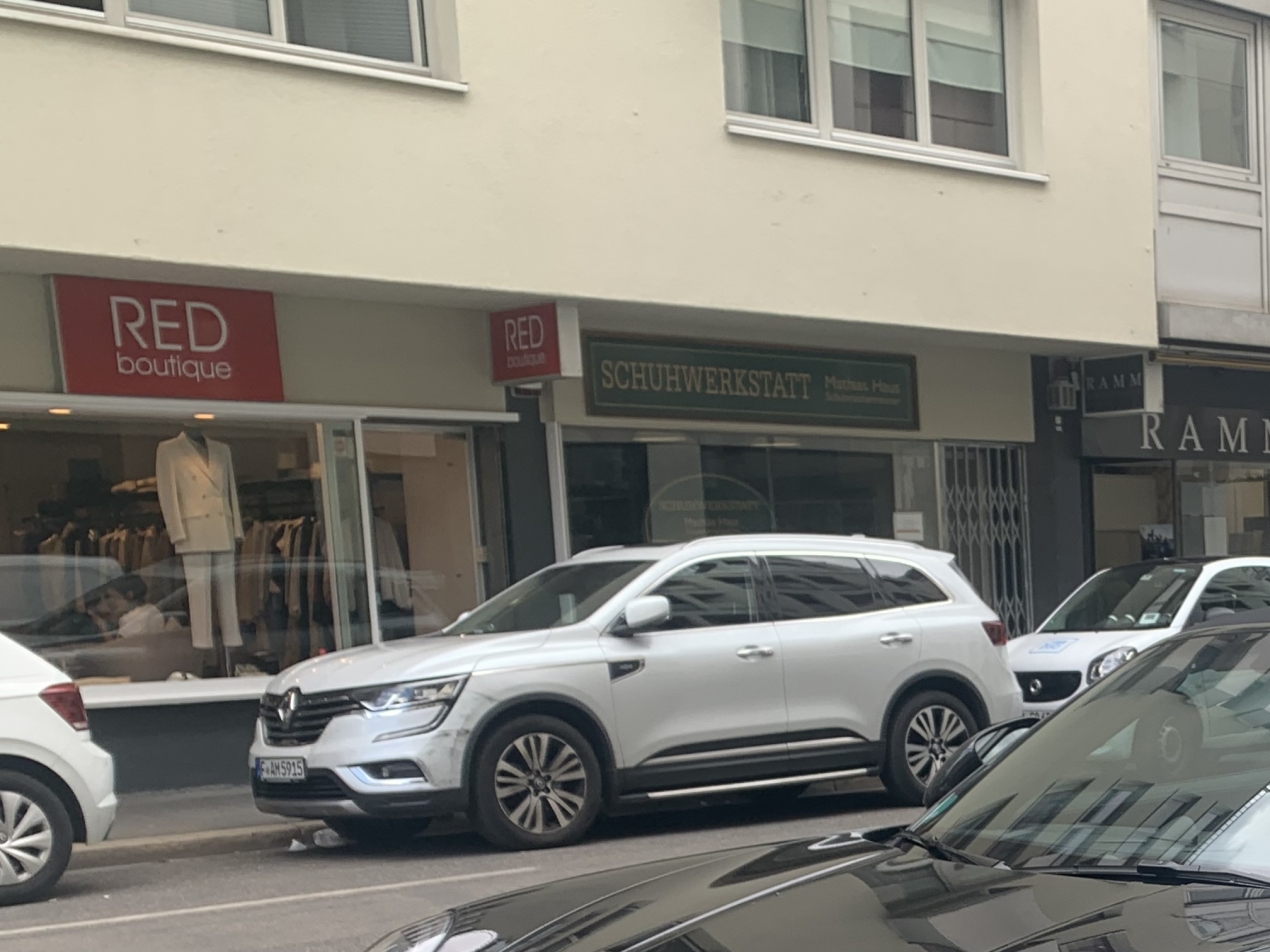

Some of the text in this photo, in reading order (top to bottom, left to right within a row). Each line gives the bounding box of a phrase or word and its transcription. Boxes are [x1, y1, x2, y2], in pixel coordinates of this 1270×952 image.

[110, 296, 228, 353] RED
[504, 314, 544, 352] RED
[116, 351, 232, 382] boutique
[600, 359, 812, 400] SCHUHWERKSTATT
[1086, 372, 1141, 391] RAMM
